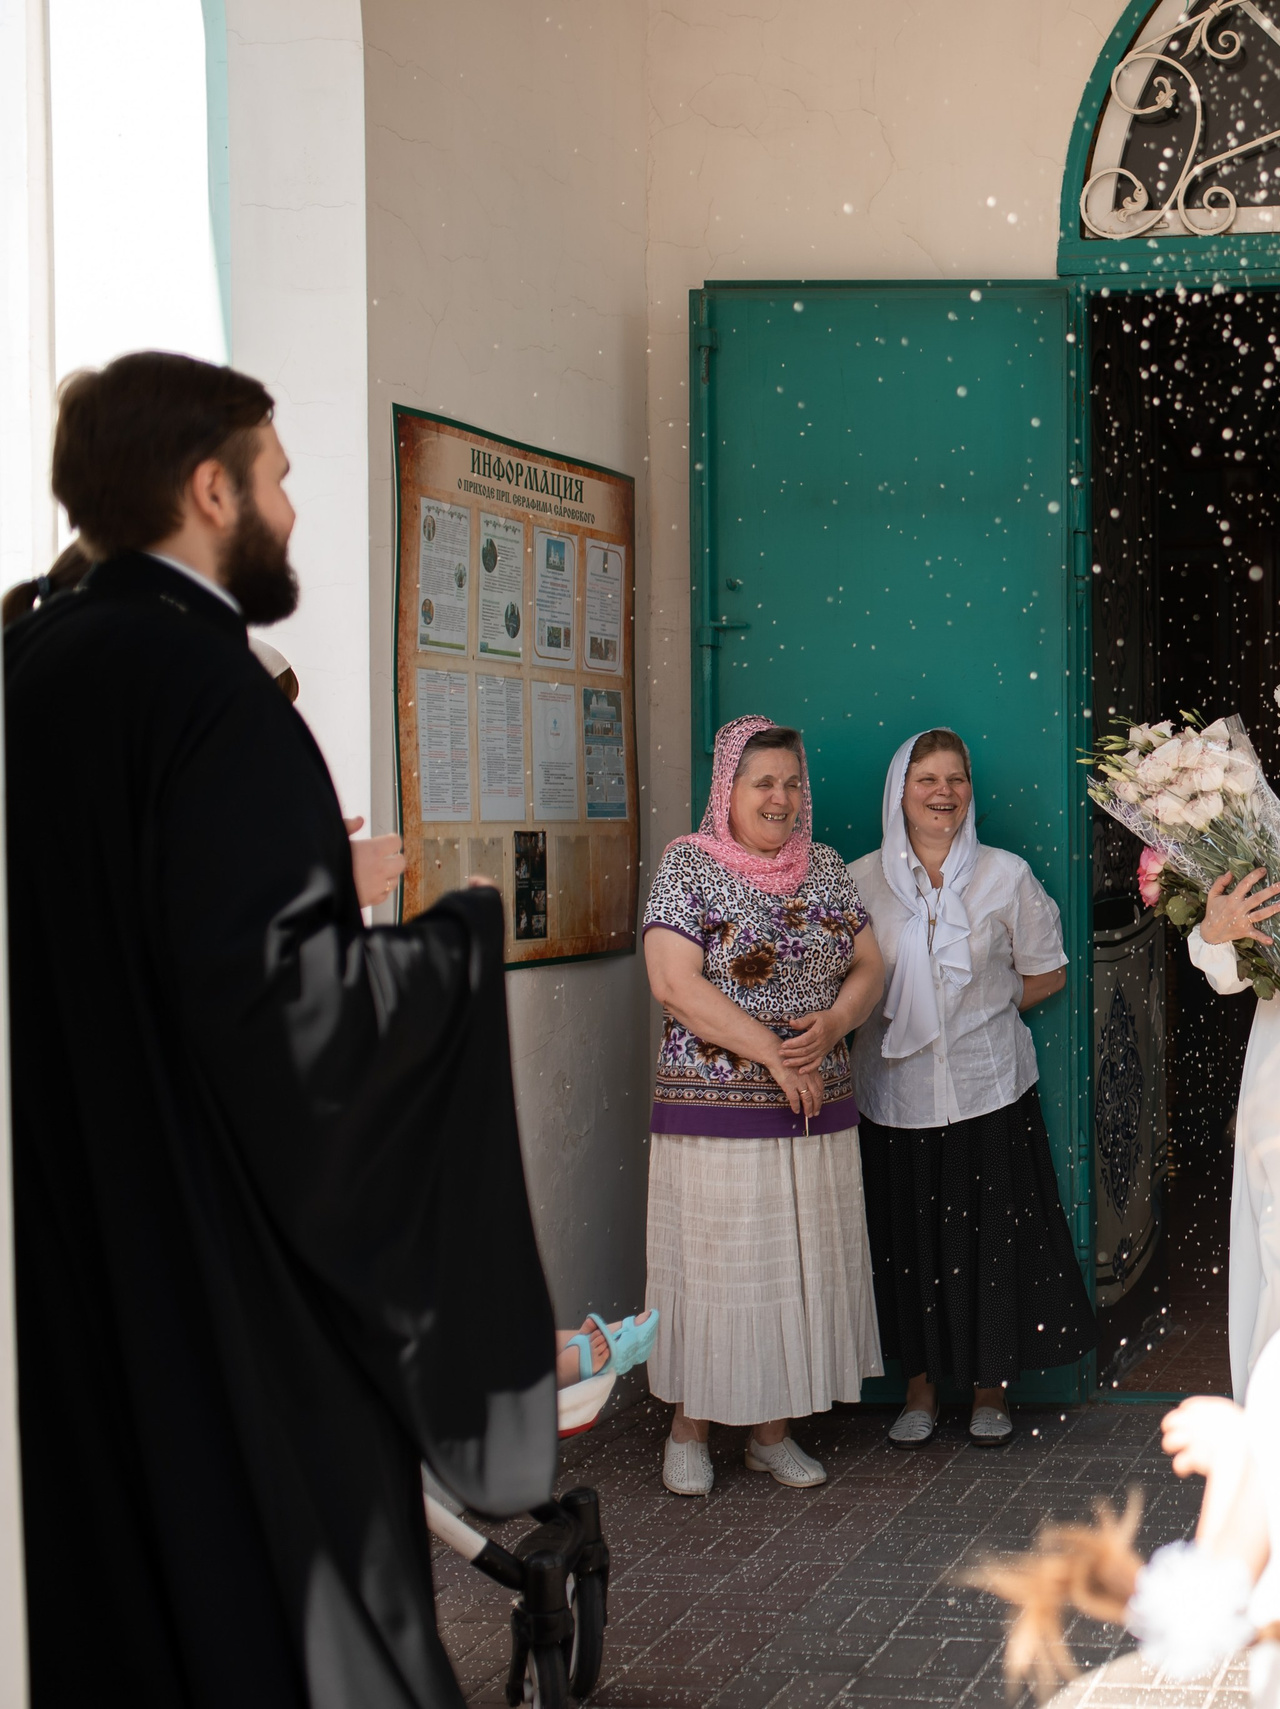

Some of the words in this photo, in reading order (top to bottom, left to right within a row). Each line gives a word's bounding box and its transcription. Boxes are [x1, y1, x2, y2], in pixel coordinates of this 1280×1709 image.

[457, 478, 463, 490] О
[463, 479, 495, 500] ПРИХОДЕ
[496, 488, 512, 504] ПРП.
[512, 494, 553, 514] СЕРАФИМА
[553, 504, 596, 525] САРОВСКОГО
[470, 448, 585, 504] ИНФОРМАЦИЯ
